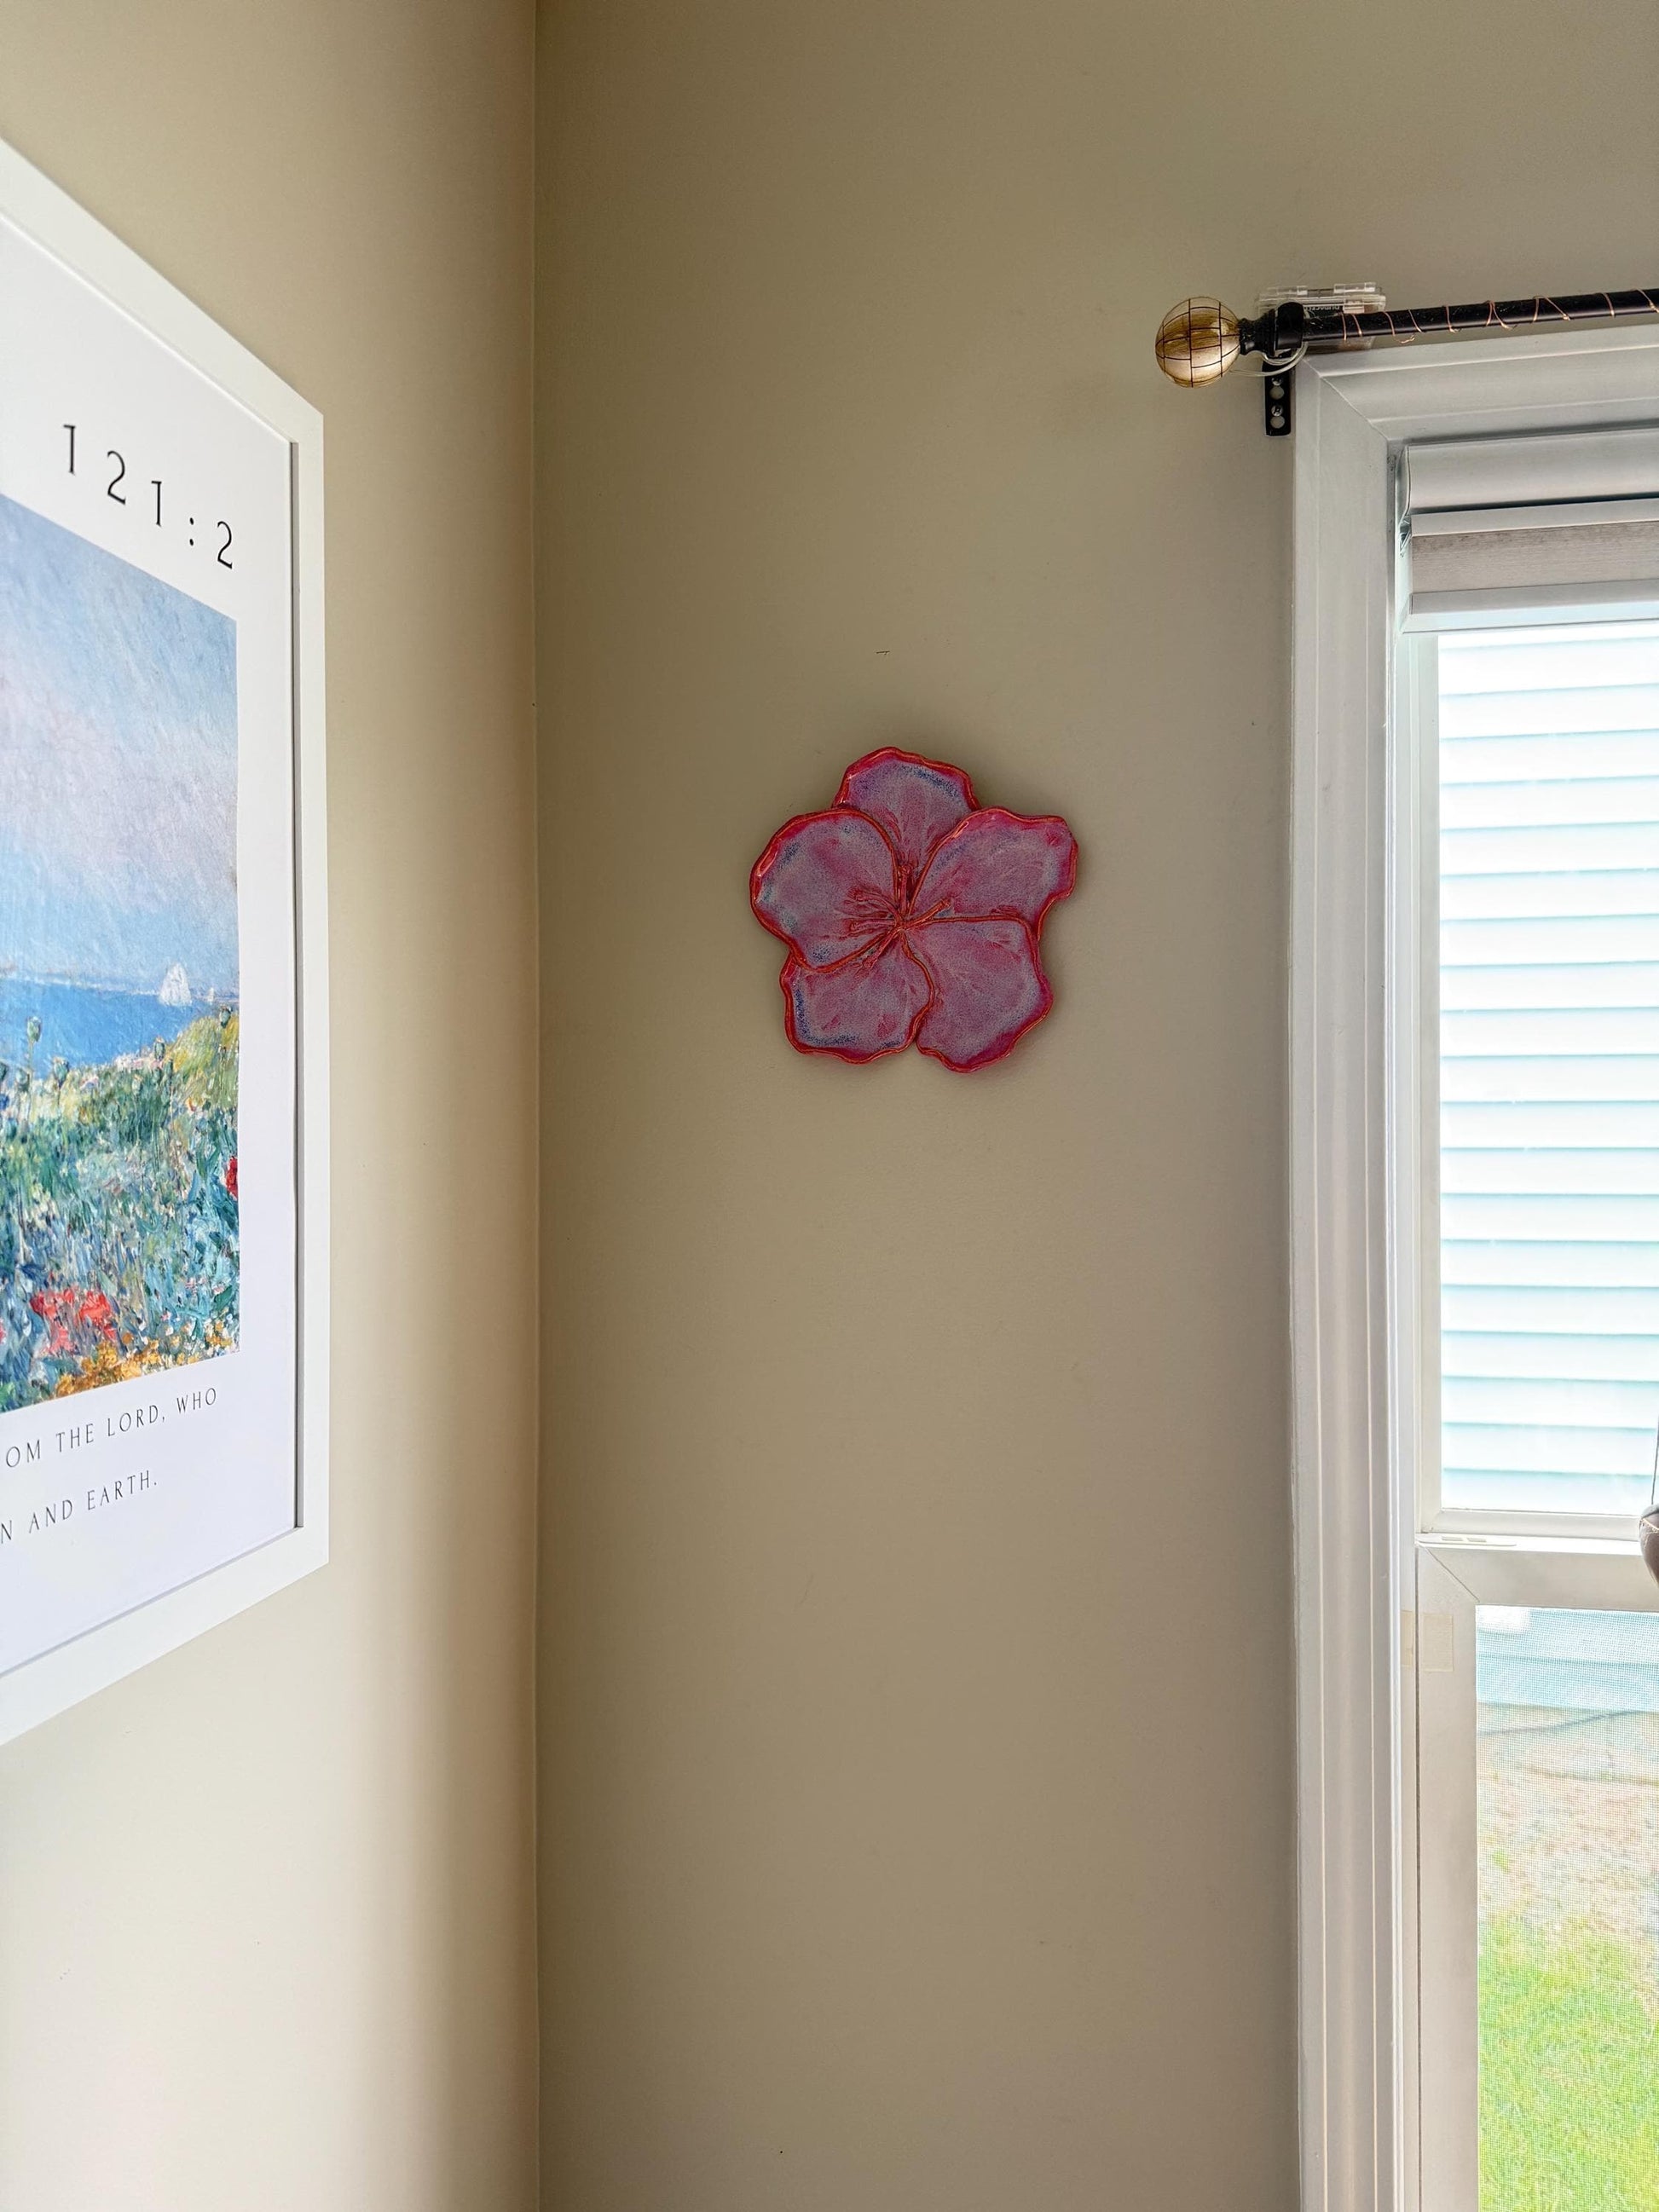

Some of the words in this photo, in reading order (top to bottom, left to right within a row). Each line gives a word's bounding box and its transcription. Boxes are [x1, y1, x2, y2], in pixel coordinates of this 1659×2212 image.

[63, 424, 233, 569] 121:2
[56, 1424, 93, 1452] THE
[108, 1405, 165, 1436] LORD,
[176, 1388, 216, 1413] WHO
[29, 1499, 72, 1533] AND
[88, 1470, 156, 1510] EARTH.
